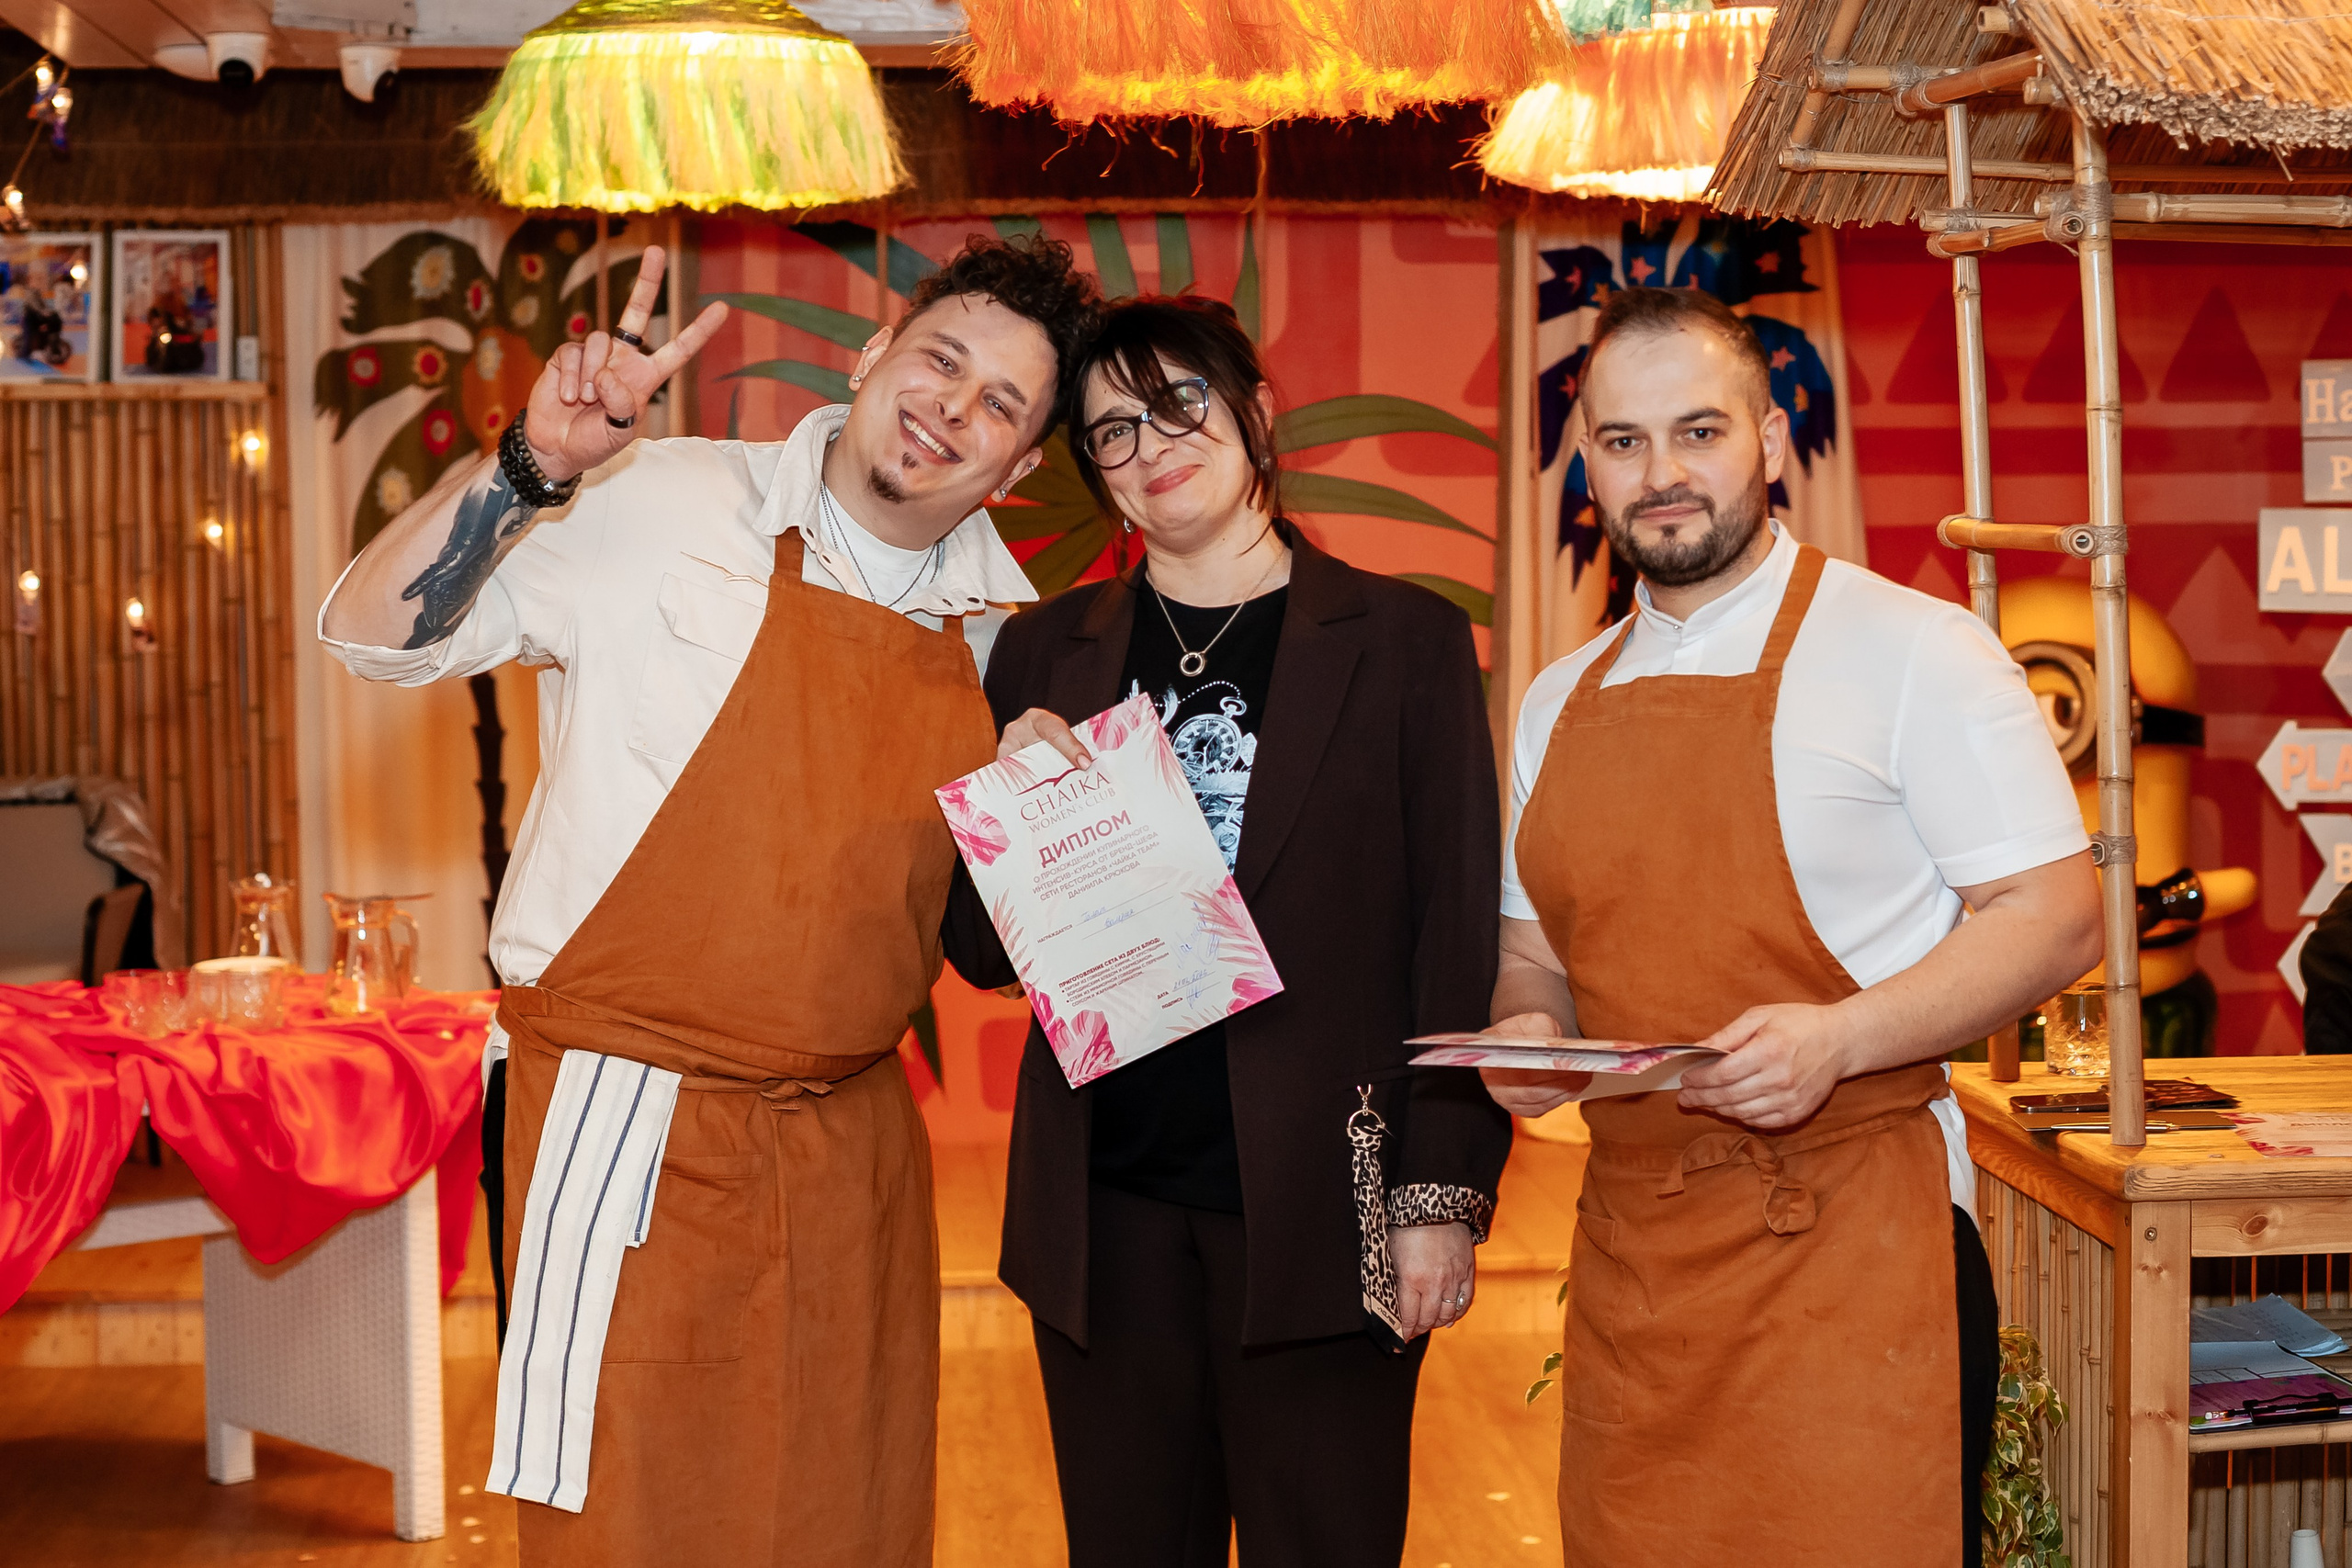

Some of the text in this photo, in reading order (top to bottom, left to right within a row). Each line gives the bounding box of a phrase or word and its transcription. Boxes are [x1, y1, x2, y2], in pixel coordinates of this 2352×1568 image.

[2267, 525, 2352, 593] AL
[1020, 771, 1110, 821] CHAIKA
[1084, 786, 1115, 807] CLUB
[1033, 824, 1149, 884] О ПРОХОЖДЕНИИ КУЛИНАРНОГО
[1037, 809, 1131, 868] ДИПЛОМ
[1032, 830, 1158, 894] ИНТЕНСИВ-КУРСА ОТ БРЕНД-ШЕФА
[1067, 860, 1140, 899] ДАНИИЛА КРЮКОВА
[1039, 886, 1059, 901] СЕТИ
[1058, 864, 1108, 892] РЕСТОРАНОВ
[1057, 963, 1104, 987] ПРИГОТОВЛЕНИЕ
[1103, 956, 1118, 966] СЕТА
[1157, 990, 1169, 999] ДАТА
[1160, 997, 1183, 1009] ПОДПИСЬ
